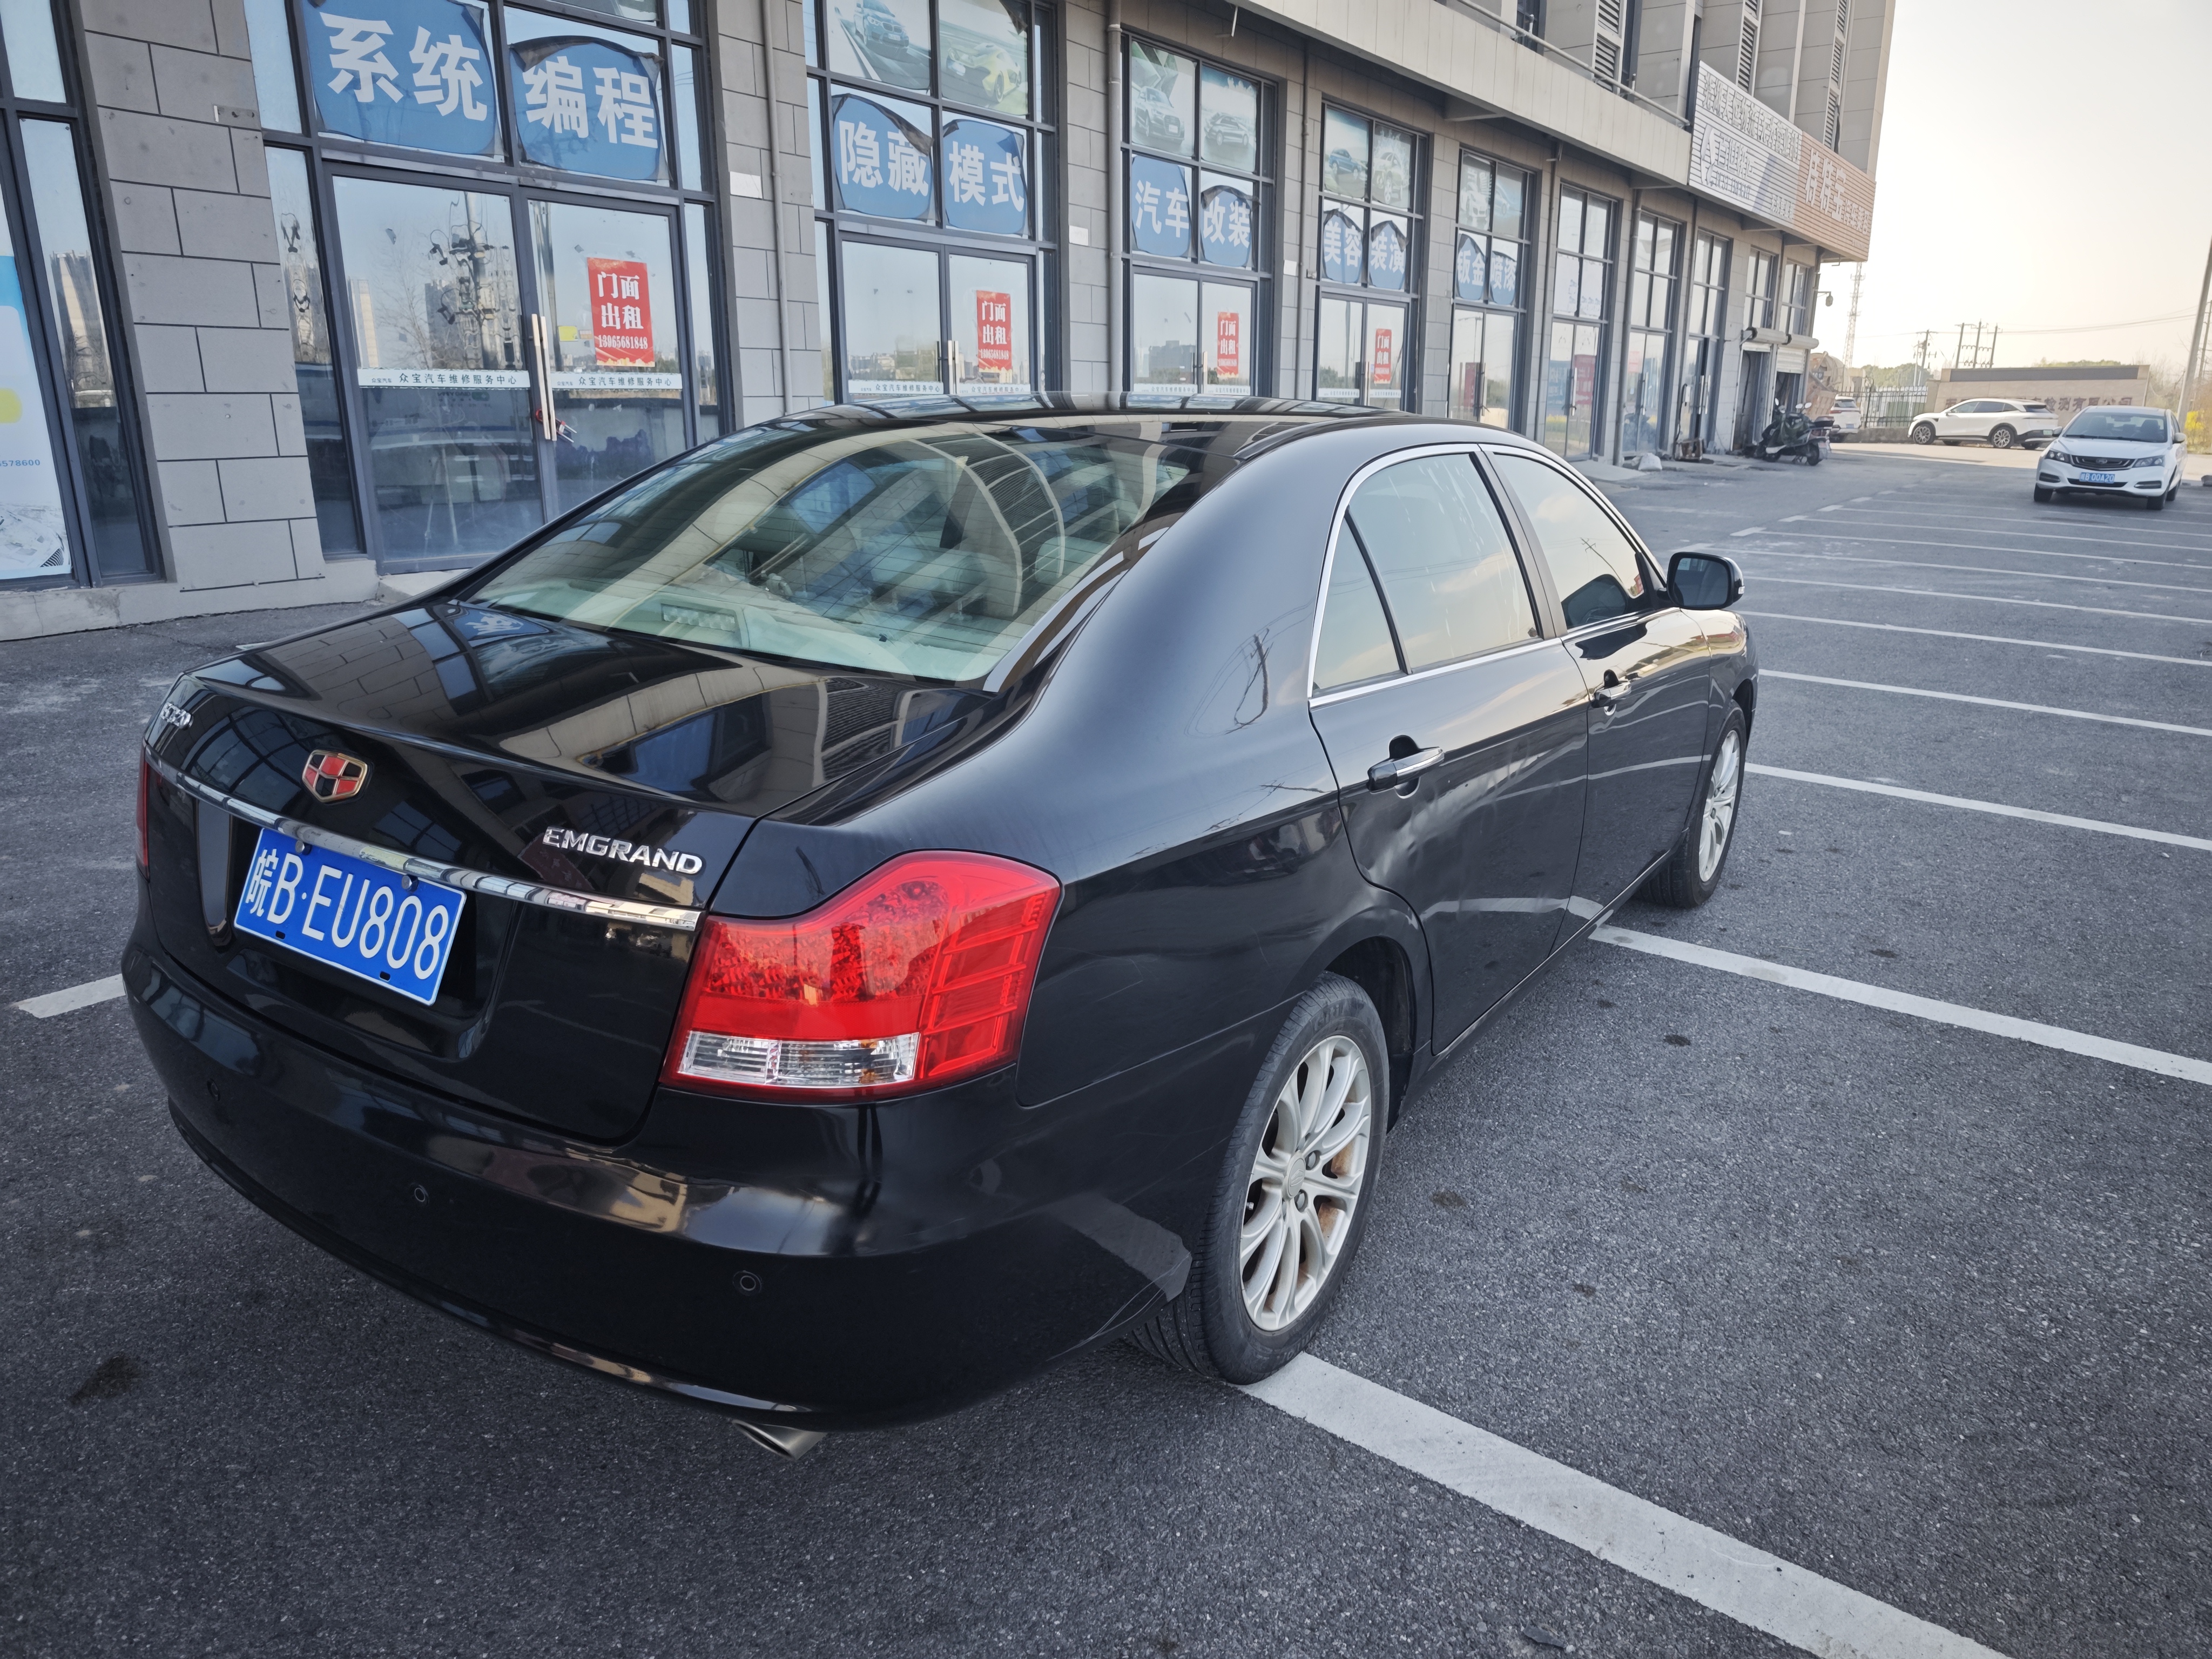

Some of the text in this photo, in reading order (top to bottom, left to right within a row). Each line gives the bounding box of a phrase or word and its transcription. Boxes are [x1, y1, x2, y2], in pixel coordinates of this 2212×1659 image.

[320, 12, 658, 149] 系统 编程
[839, 120, 1024, 212] 隐藏 模式
[1135, 180, 1250, 248] 汽车 改装
[1324, 220, 1405, 274] 美容 装潢
[1458, 250, 1517, 291] 钣金 喷漆
[597, 271, 640, 300] 门面
[601, 302, 644, 329] 出租
[982, 300, 1007, 322] 门面
[598, 335, 648, 349] 13965681848
[983, 324, 1007, 345] 出租
[399, 373, 517, 384] 众宝汽车维修服务中心
[578, 376, 672, 386] 众宝汽车维修服务中心
[875, 384, 940, 392] 众宝汽车维修服务中心
[542, 826, 702, 874] EMGRAND
[245, 848, 449, 980] 皖B·EU808
